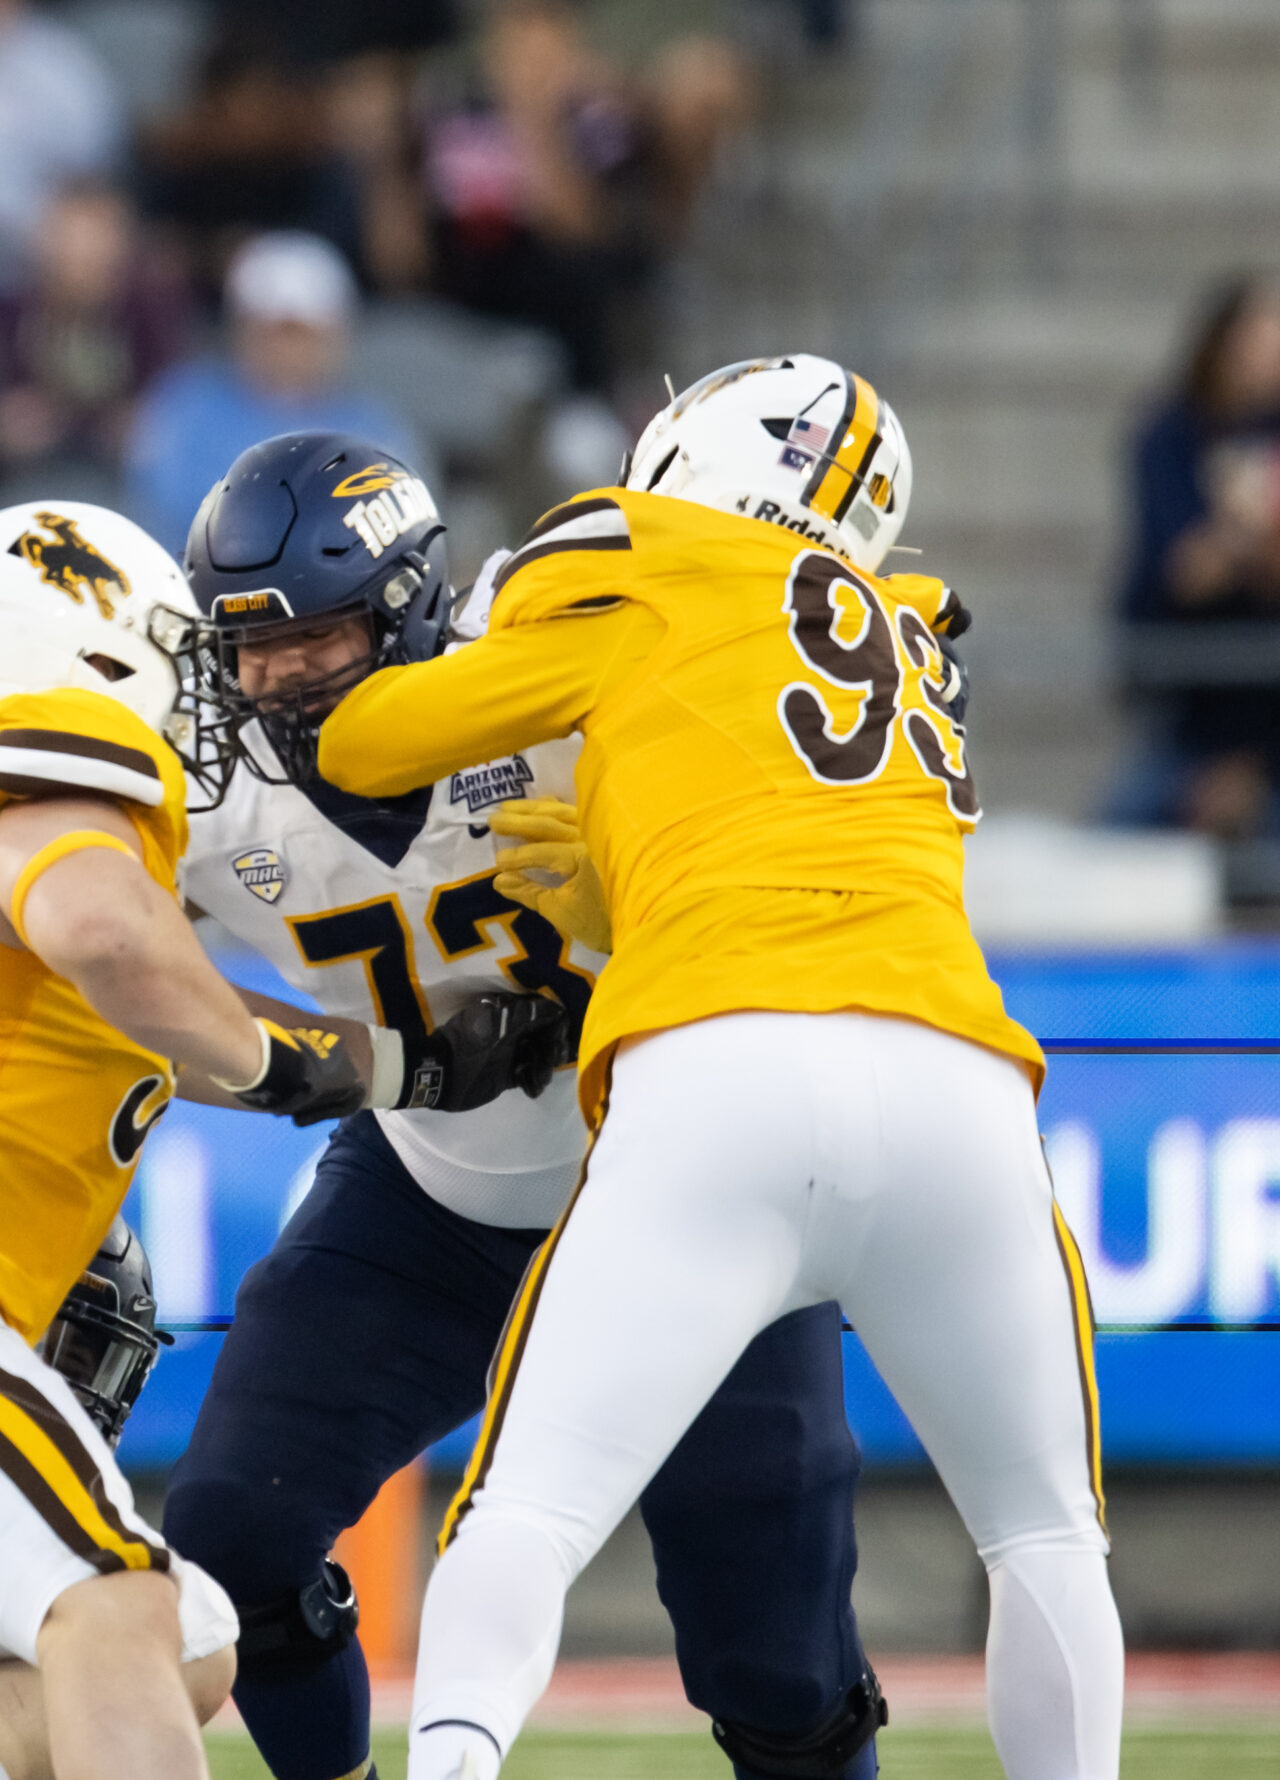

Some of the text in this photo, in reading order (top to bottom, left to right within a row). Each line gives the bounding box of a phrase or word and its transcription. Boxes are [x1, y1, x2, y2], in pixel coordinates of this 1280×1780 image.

[754, 499, 850, 559] Ridd
[455, 761, 526, 794] ARIZONA
[471, 779, 519, 804] BOWL
[283, 867, 597, 1071] 73
